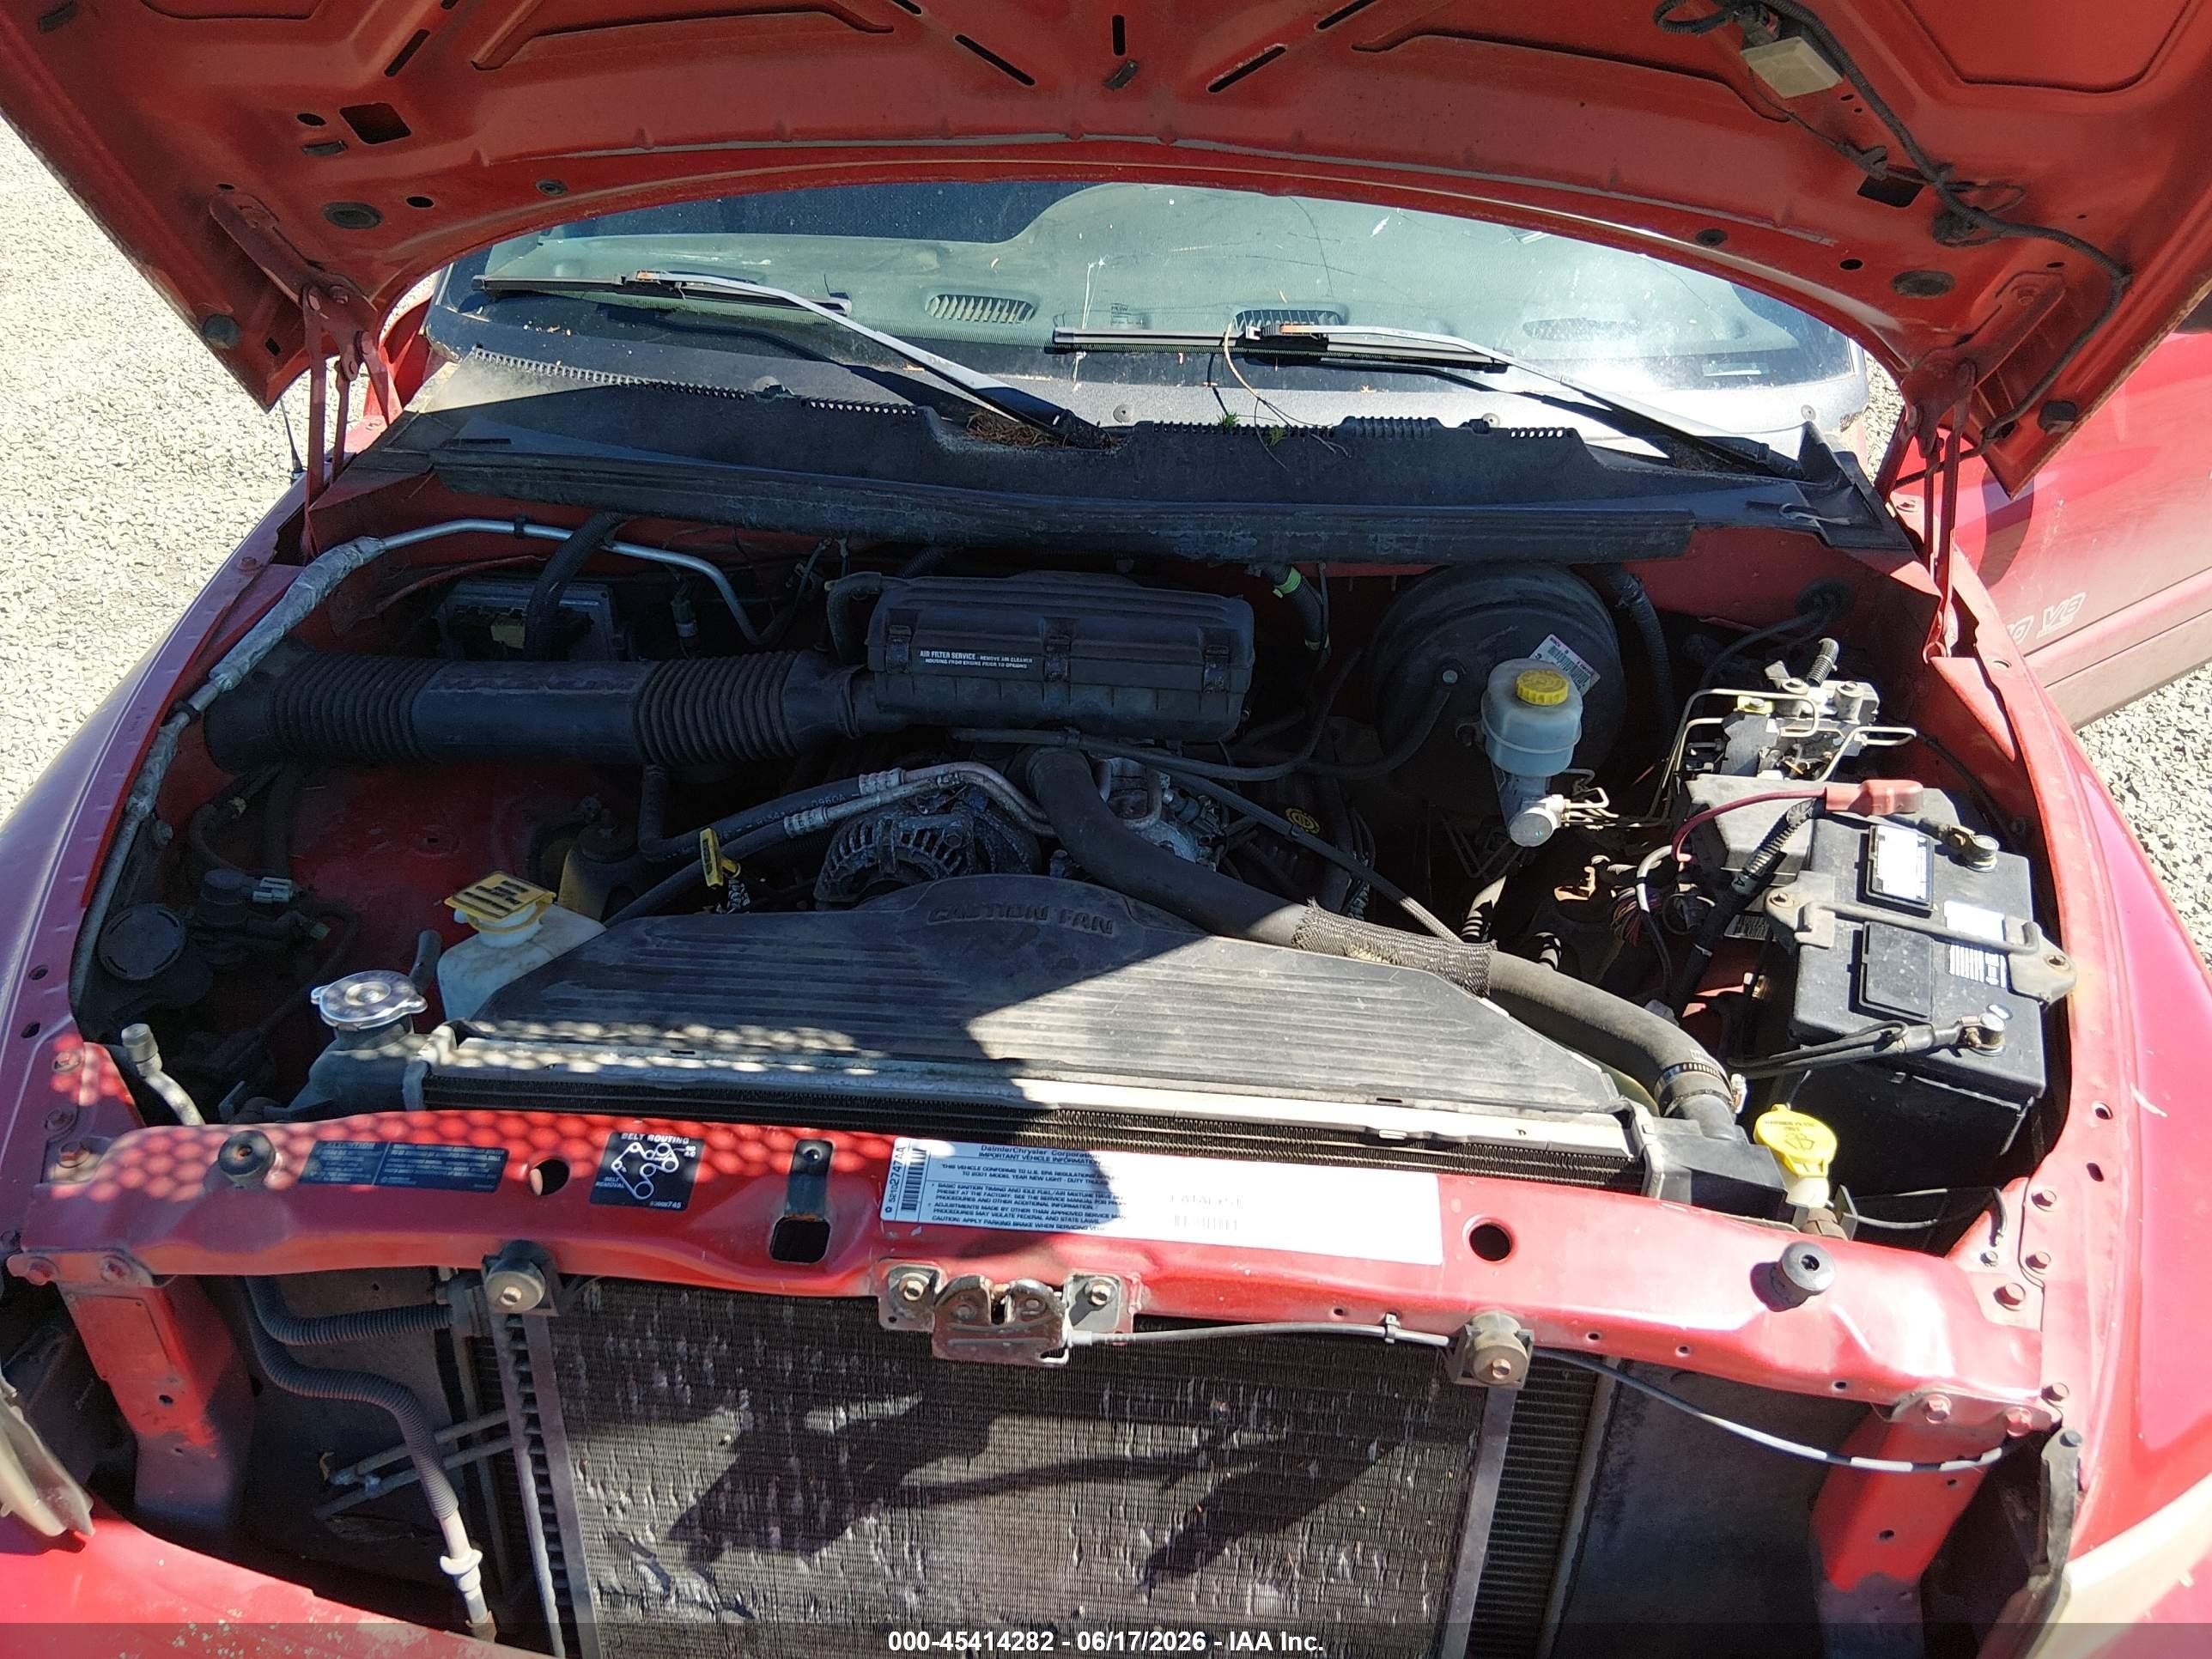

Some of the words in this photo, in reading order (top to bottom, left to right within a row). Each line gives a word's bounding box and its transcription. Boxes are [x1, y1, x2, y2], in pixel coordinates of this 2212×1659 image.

[931, 650, 951, 659] FILTER
[1058, 907, 1114, 935] FAN
[647, 1134, 690, 1144] ROUTING
[981, 1145, 1046, 1156] DaimlerChrysler
